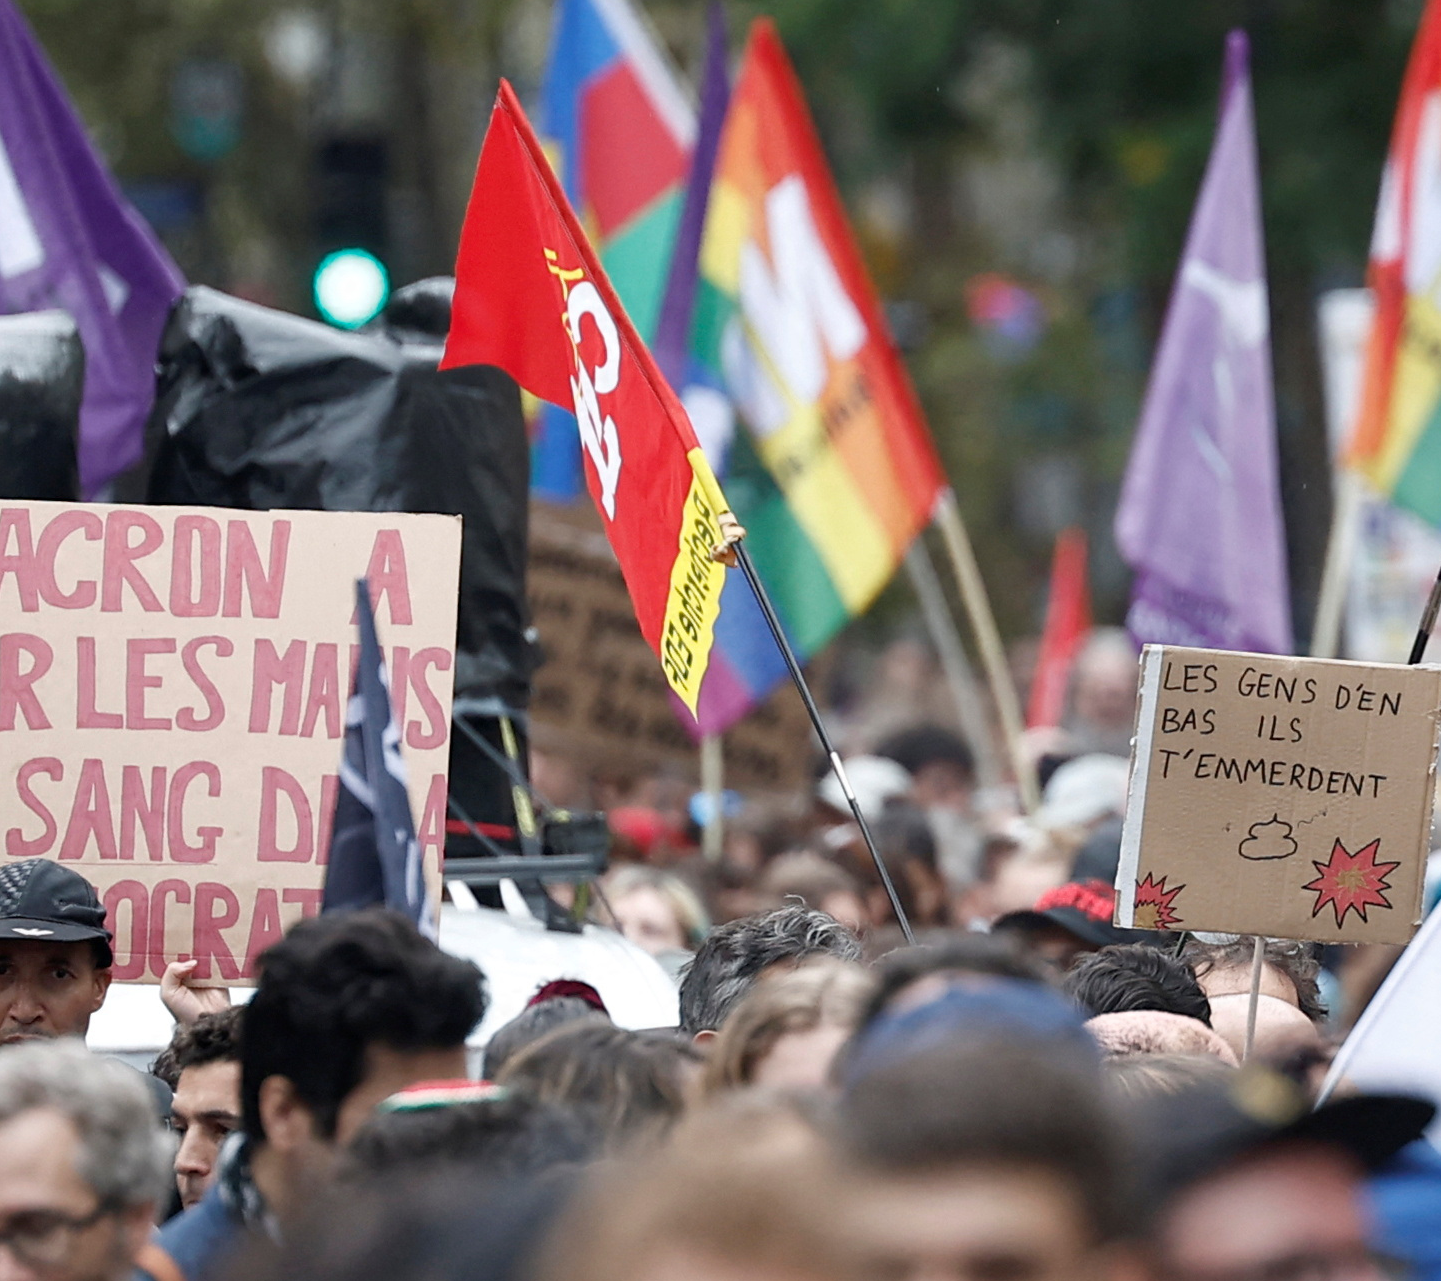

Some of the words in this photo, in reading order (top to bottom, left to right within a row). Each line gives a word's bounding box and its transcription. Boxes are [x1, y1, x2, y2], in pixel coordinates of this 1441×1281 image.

[349, 529, 413, 625] A
[76, 634, 233, 732] LES
[248, 638, 452, 749] MAS
[1161, 708, 1216, 735] BAS
[1258, 715, 1303, 742] ILS
[1163, 662, 1218, 693] LES
[1237, 667, 1317, 703] GENS
[1335, 683, 1401, 716] D'EN
[6, 757, 224, 862] SANG
[1159, 748, 1387, 798] T'EMMERDENT
